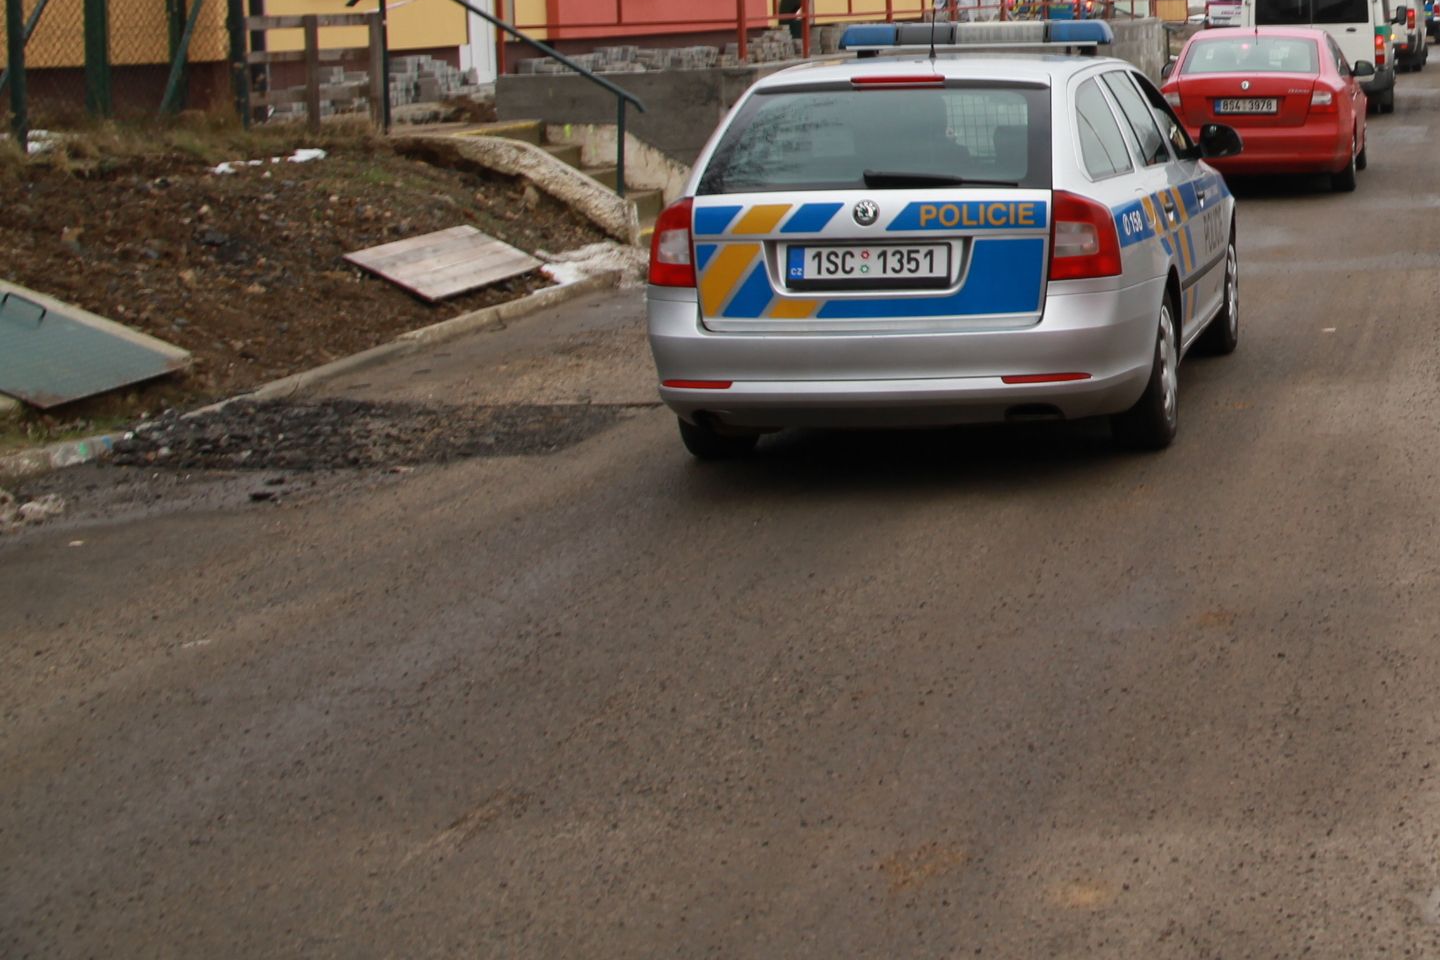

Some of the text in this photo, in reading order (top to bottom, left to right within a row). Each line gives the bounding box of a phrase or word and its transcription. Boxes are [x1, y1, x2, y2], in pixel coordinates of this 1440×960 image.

[918, 203, 1035, 227] POLICIE
[1129, 210, 1143, 233] 158
[790, 267, 802, 276] CZ
[811, 248, 935, 276] 1SC 1351
